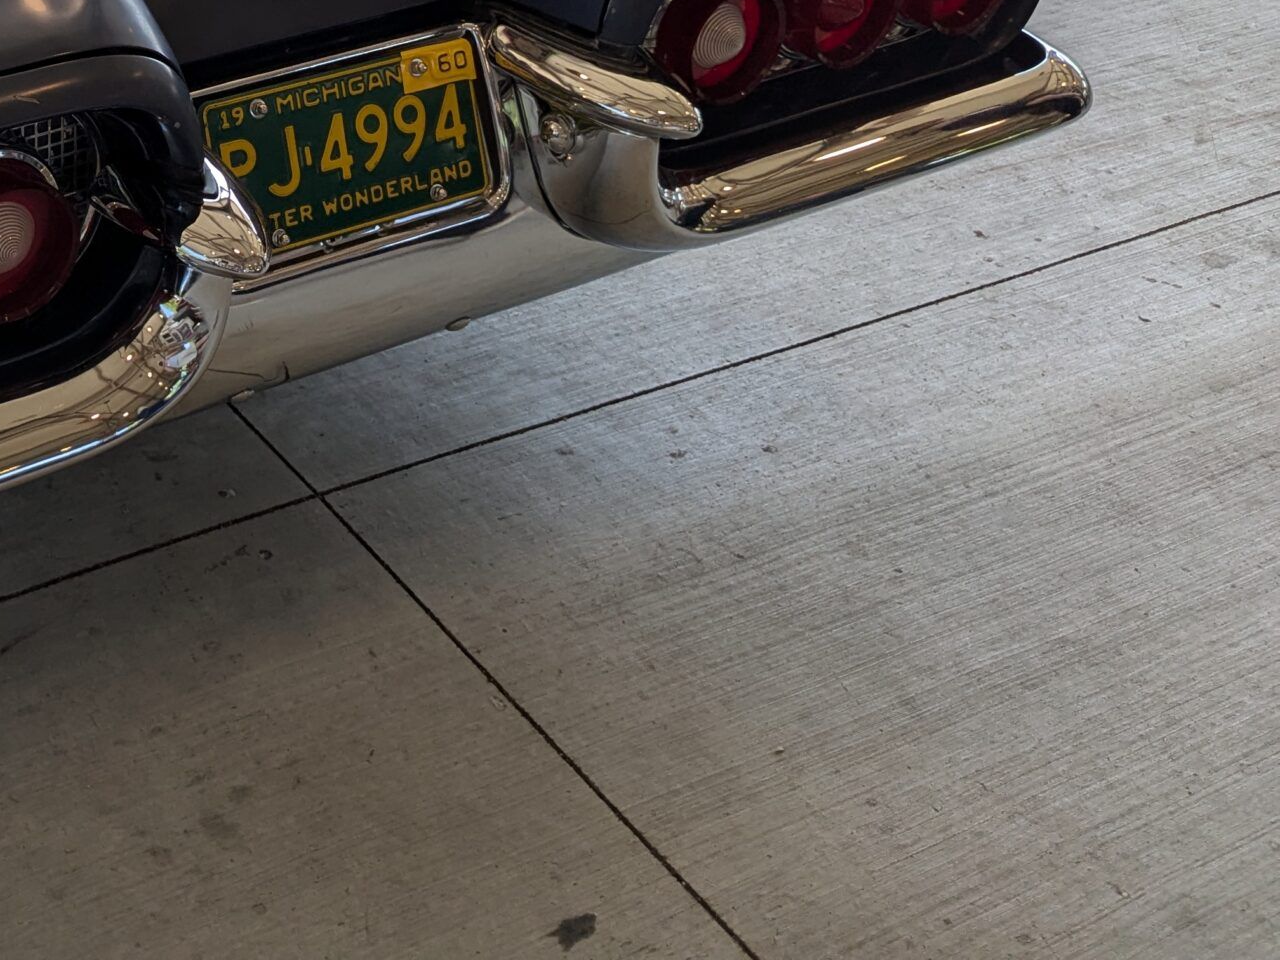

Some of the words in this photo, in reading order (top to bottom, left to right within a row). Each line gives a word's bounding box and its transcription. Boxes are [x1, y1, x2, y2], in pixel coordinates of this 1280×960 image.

[220, 105, 244, 129] 19
[275, 65, 403, 115] MICHIGAN
[438, 50, 467, 73] 60
[270, 205, 314, 229] TER
[322, 159, 473, 217] WONDERLAND
